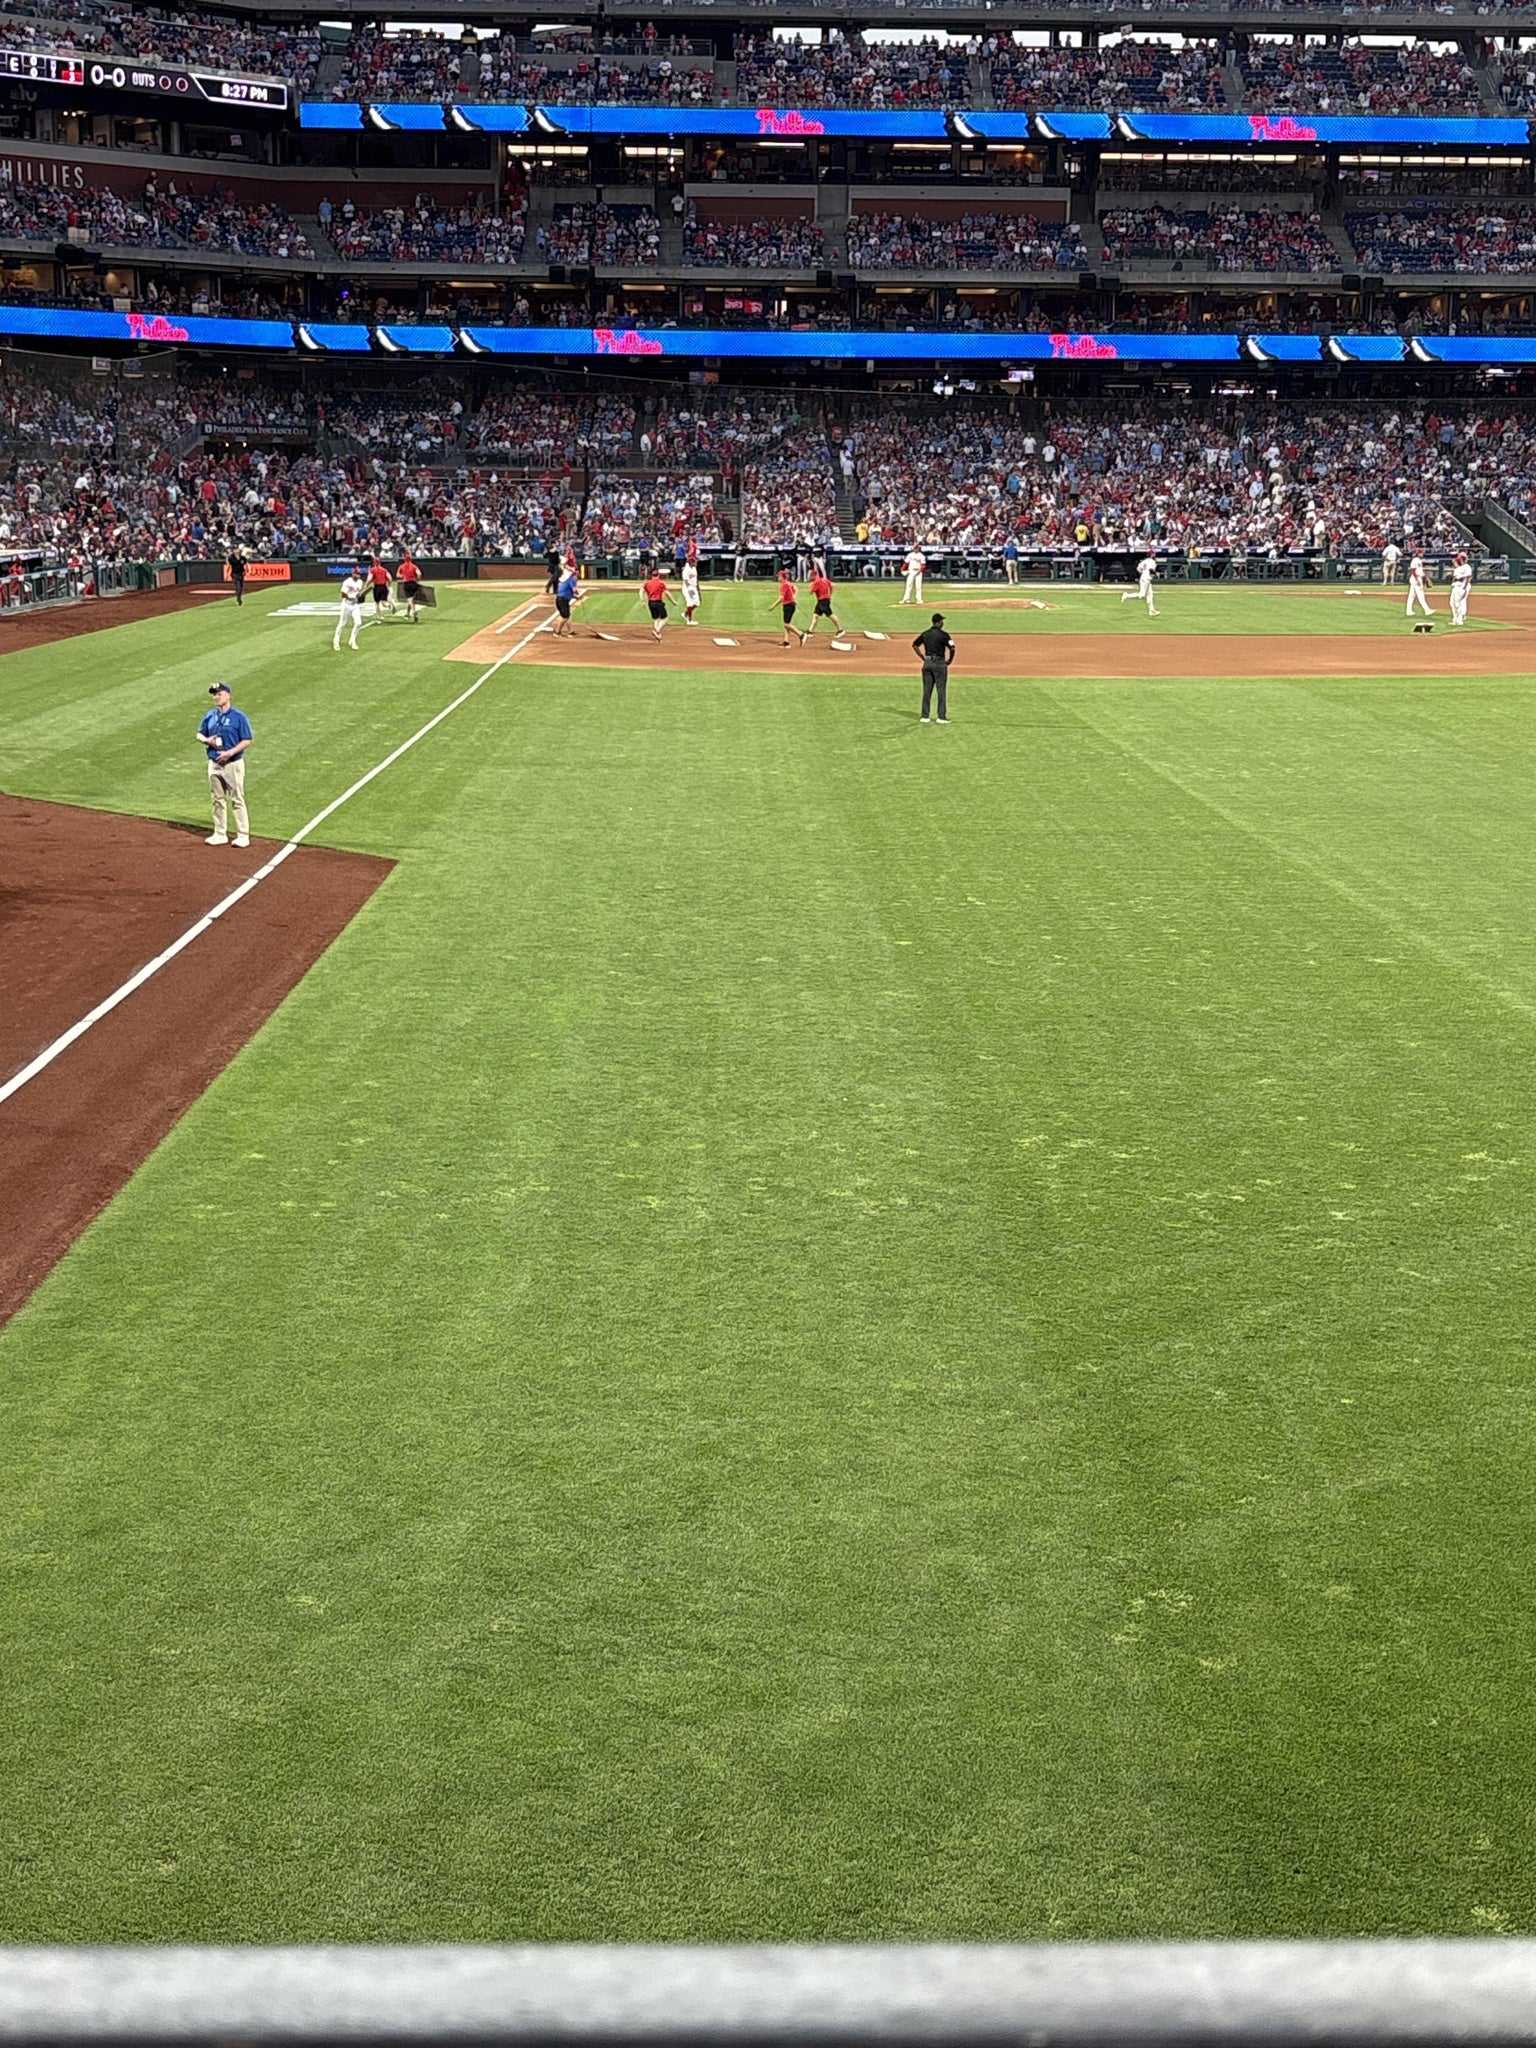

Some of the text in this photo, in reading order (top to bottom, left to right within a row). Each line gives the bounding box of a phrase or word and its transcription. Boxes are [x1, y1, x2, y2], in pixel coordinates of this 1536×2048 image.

[10, 57, 19, 72] E
[91, 65, 126, 88] 0-0
[132, 72, 155, 88] OUTS
[221, 83, 268, 101] 8:27 PM
[754, 108, 825, 135] Phillies
[1248, 115, 1317, 140] Phillies
[1, 160, 84, 189] HILLIES
[1356, 200, 1425, 209] CADILLAC
[593, 328, 663, 355] Phillies
[1048, 333, 1117, 359] Phillies
